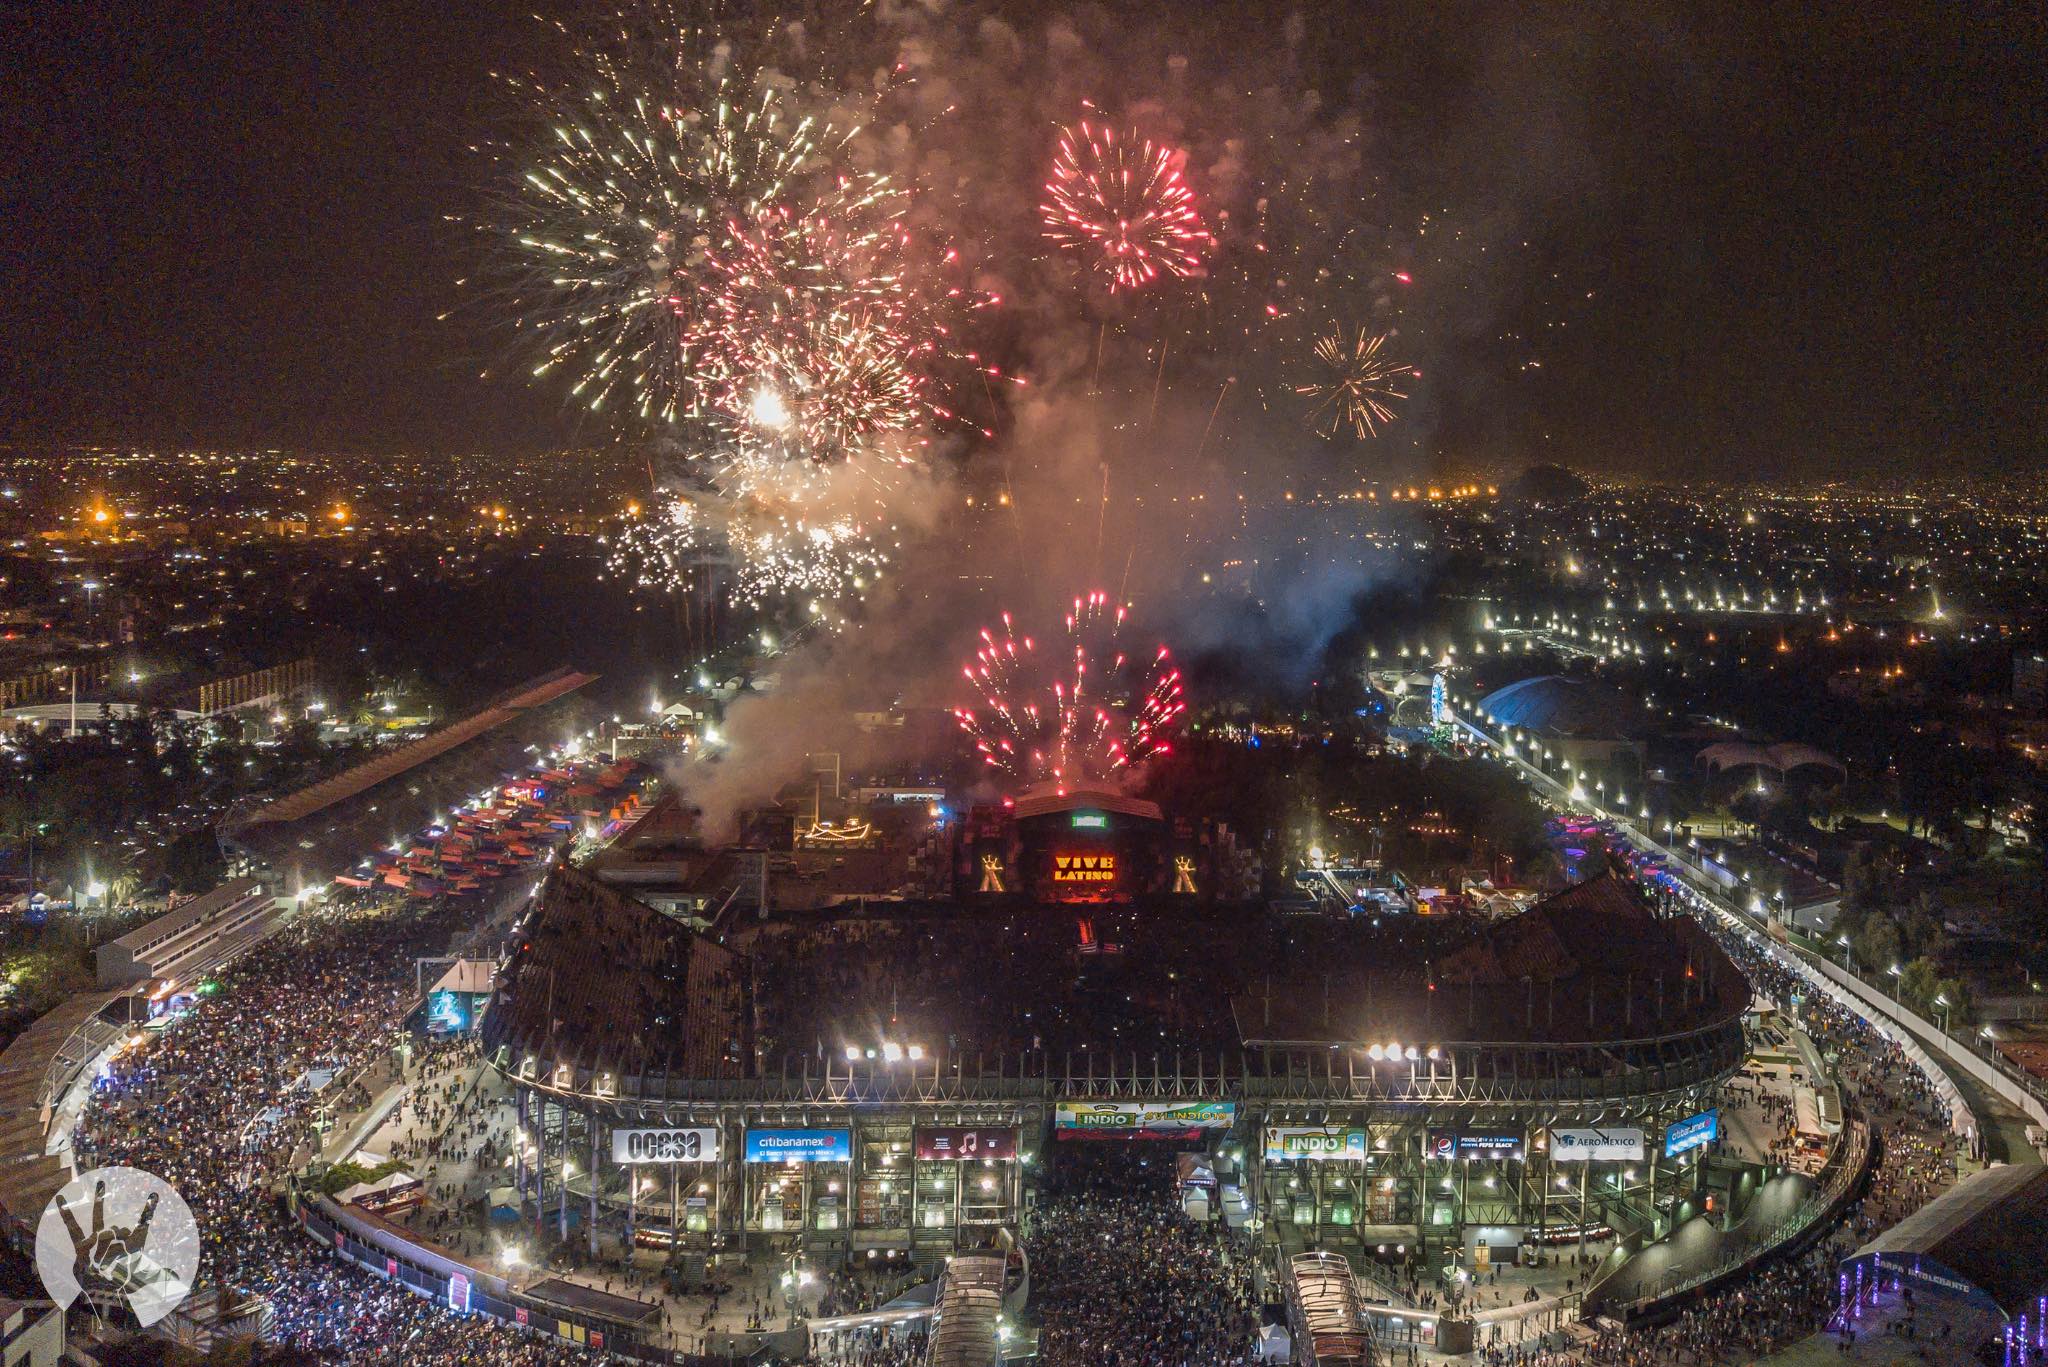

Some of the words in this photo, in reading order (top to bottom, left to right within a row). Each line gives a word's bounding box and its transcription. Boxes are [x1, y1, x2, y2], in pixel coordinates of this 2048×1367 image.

[1055, 857, 1114, 868] VIVE
[1055, 871, 1114, 880] LATINO
[1084, 1115, 1127, 1125] INDIO
[759, 1136, 824, 1147] citibanamex
[1293, 1138, 1338, 1151] INDIO
